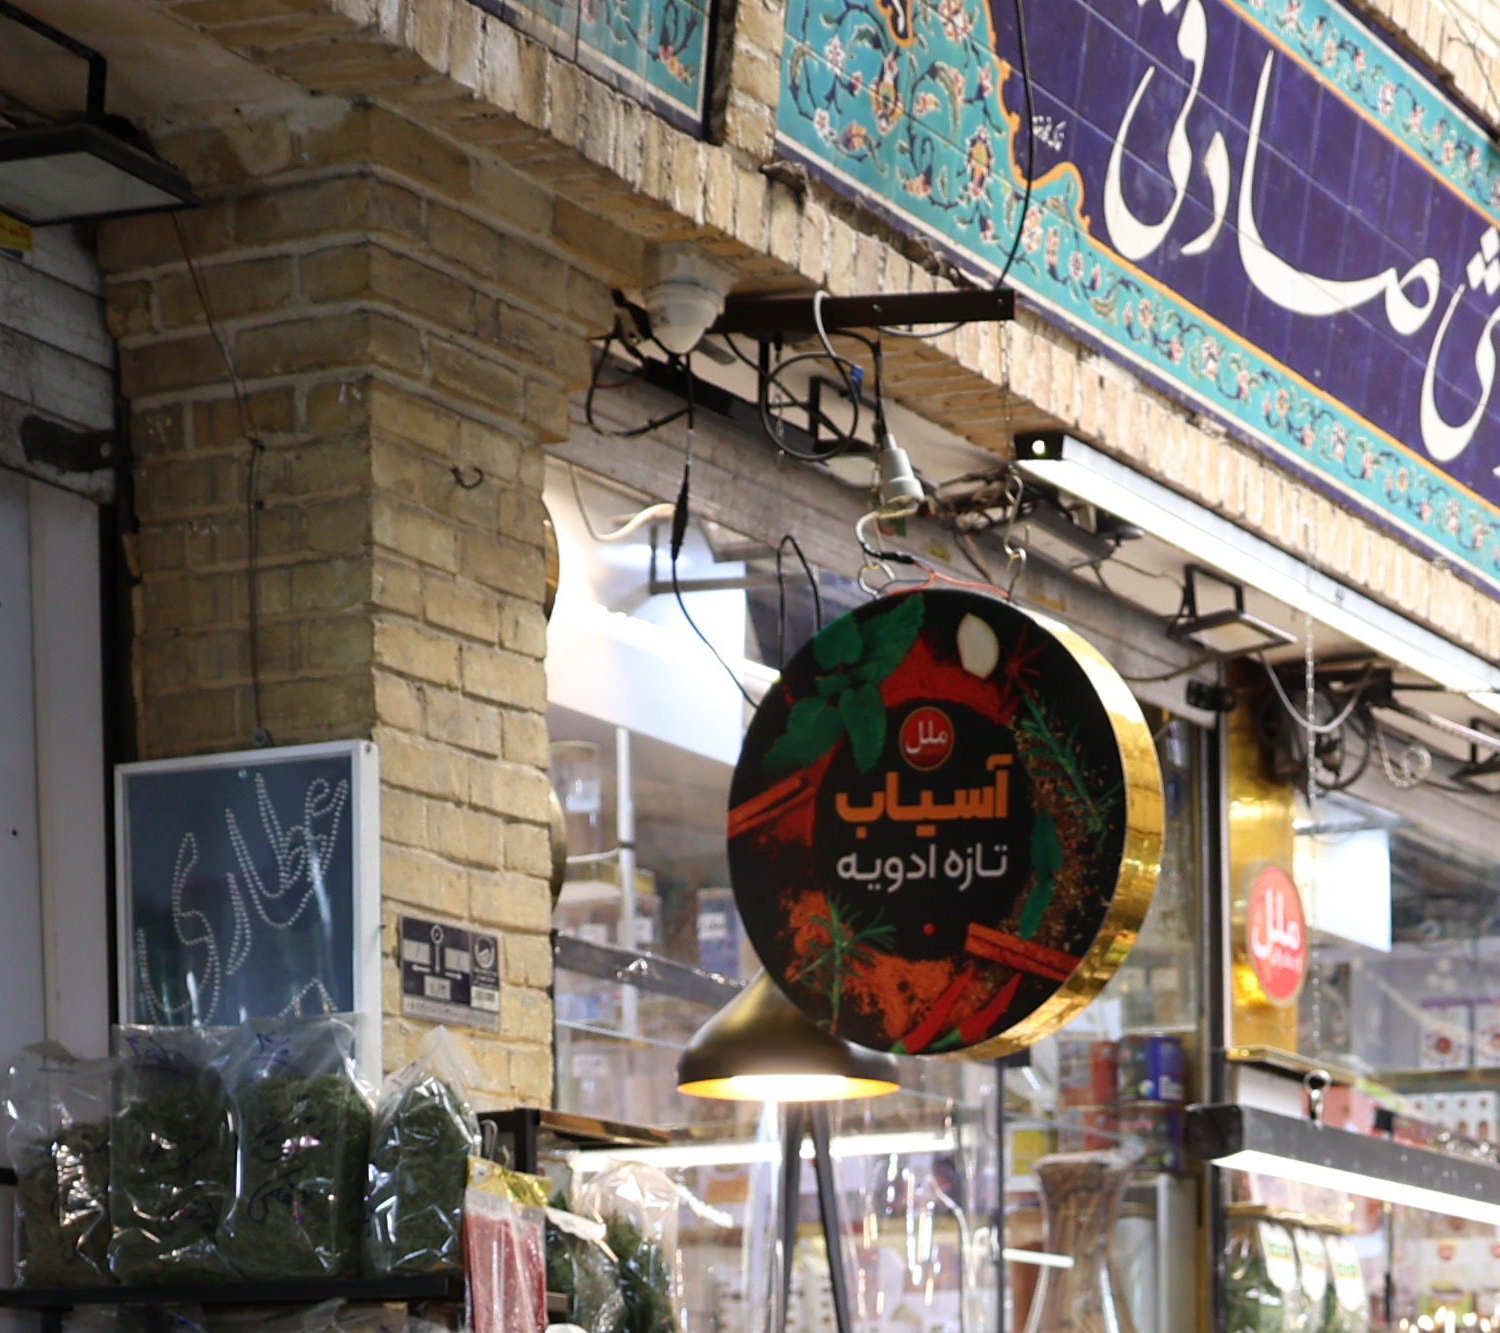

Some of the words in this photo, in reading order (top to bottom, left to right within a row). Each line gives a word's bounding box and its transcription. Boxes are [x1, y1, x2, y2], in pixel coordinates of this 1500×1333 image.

[1104, 0, 1441, 336] صادقی
[905, 720, 949, 755] ملل
[835, 753, 1014, 839] آسیاب
[836, 843, 937, 892] ادویه
[944, 842, 1009, 891] تازه
[1251, 887, 1301, 960] ملل
